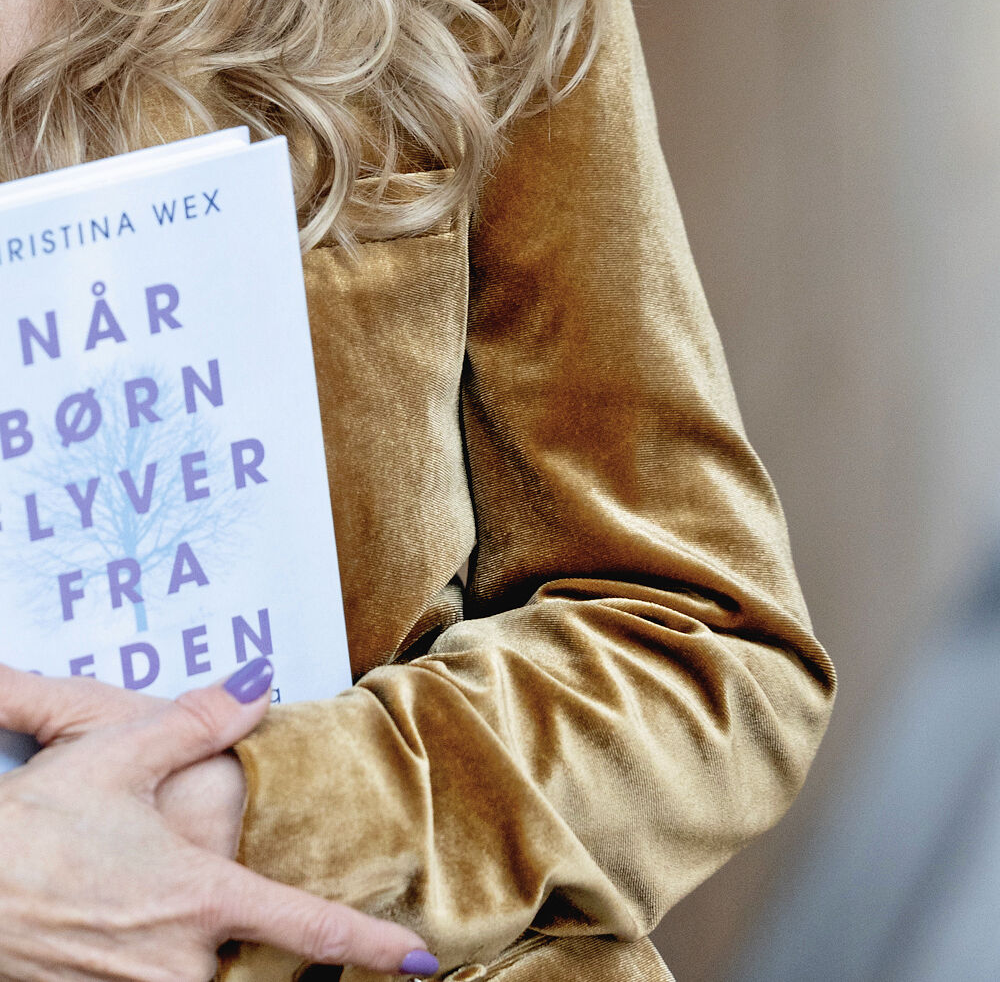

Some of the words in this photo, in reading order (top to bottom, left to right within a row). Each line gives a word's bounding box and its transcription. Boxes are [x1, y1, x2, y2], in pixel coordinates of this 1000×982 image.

[153, 189, 222, 226] WEX
[18, 281, 183, 366] NÅR
[58, 542, 210, 621] FRA
[27, 608, 274, 691] DEN
